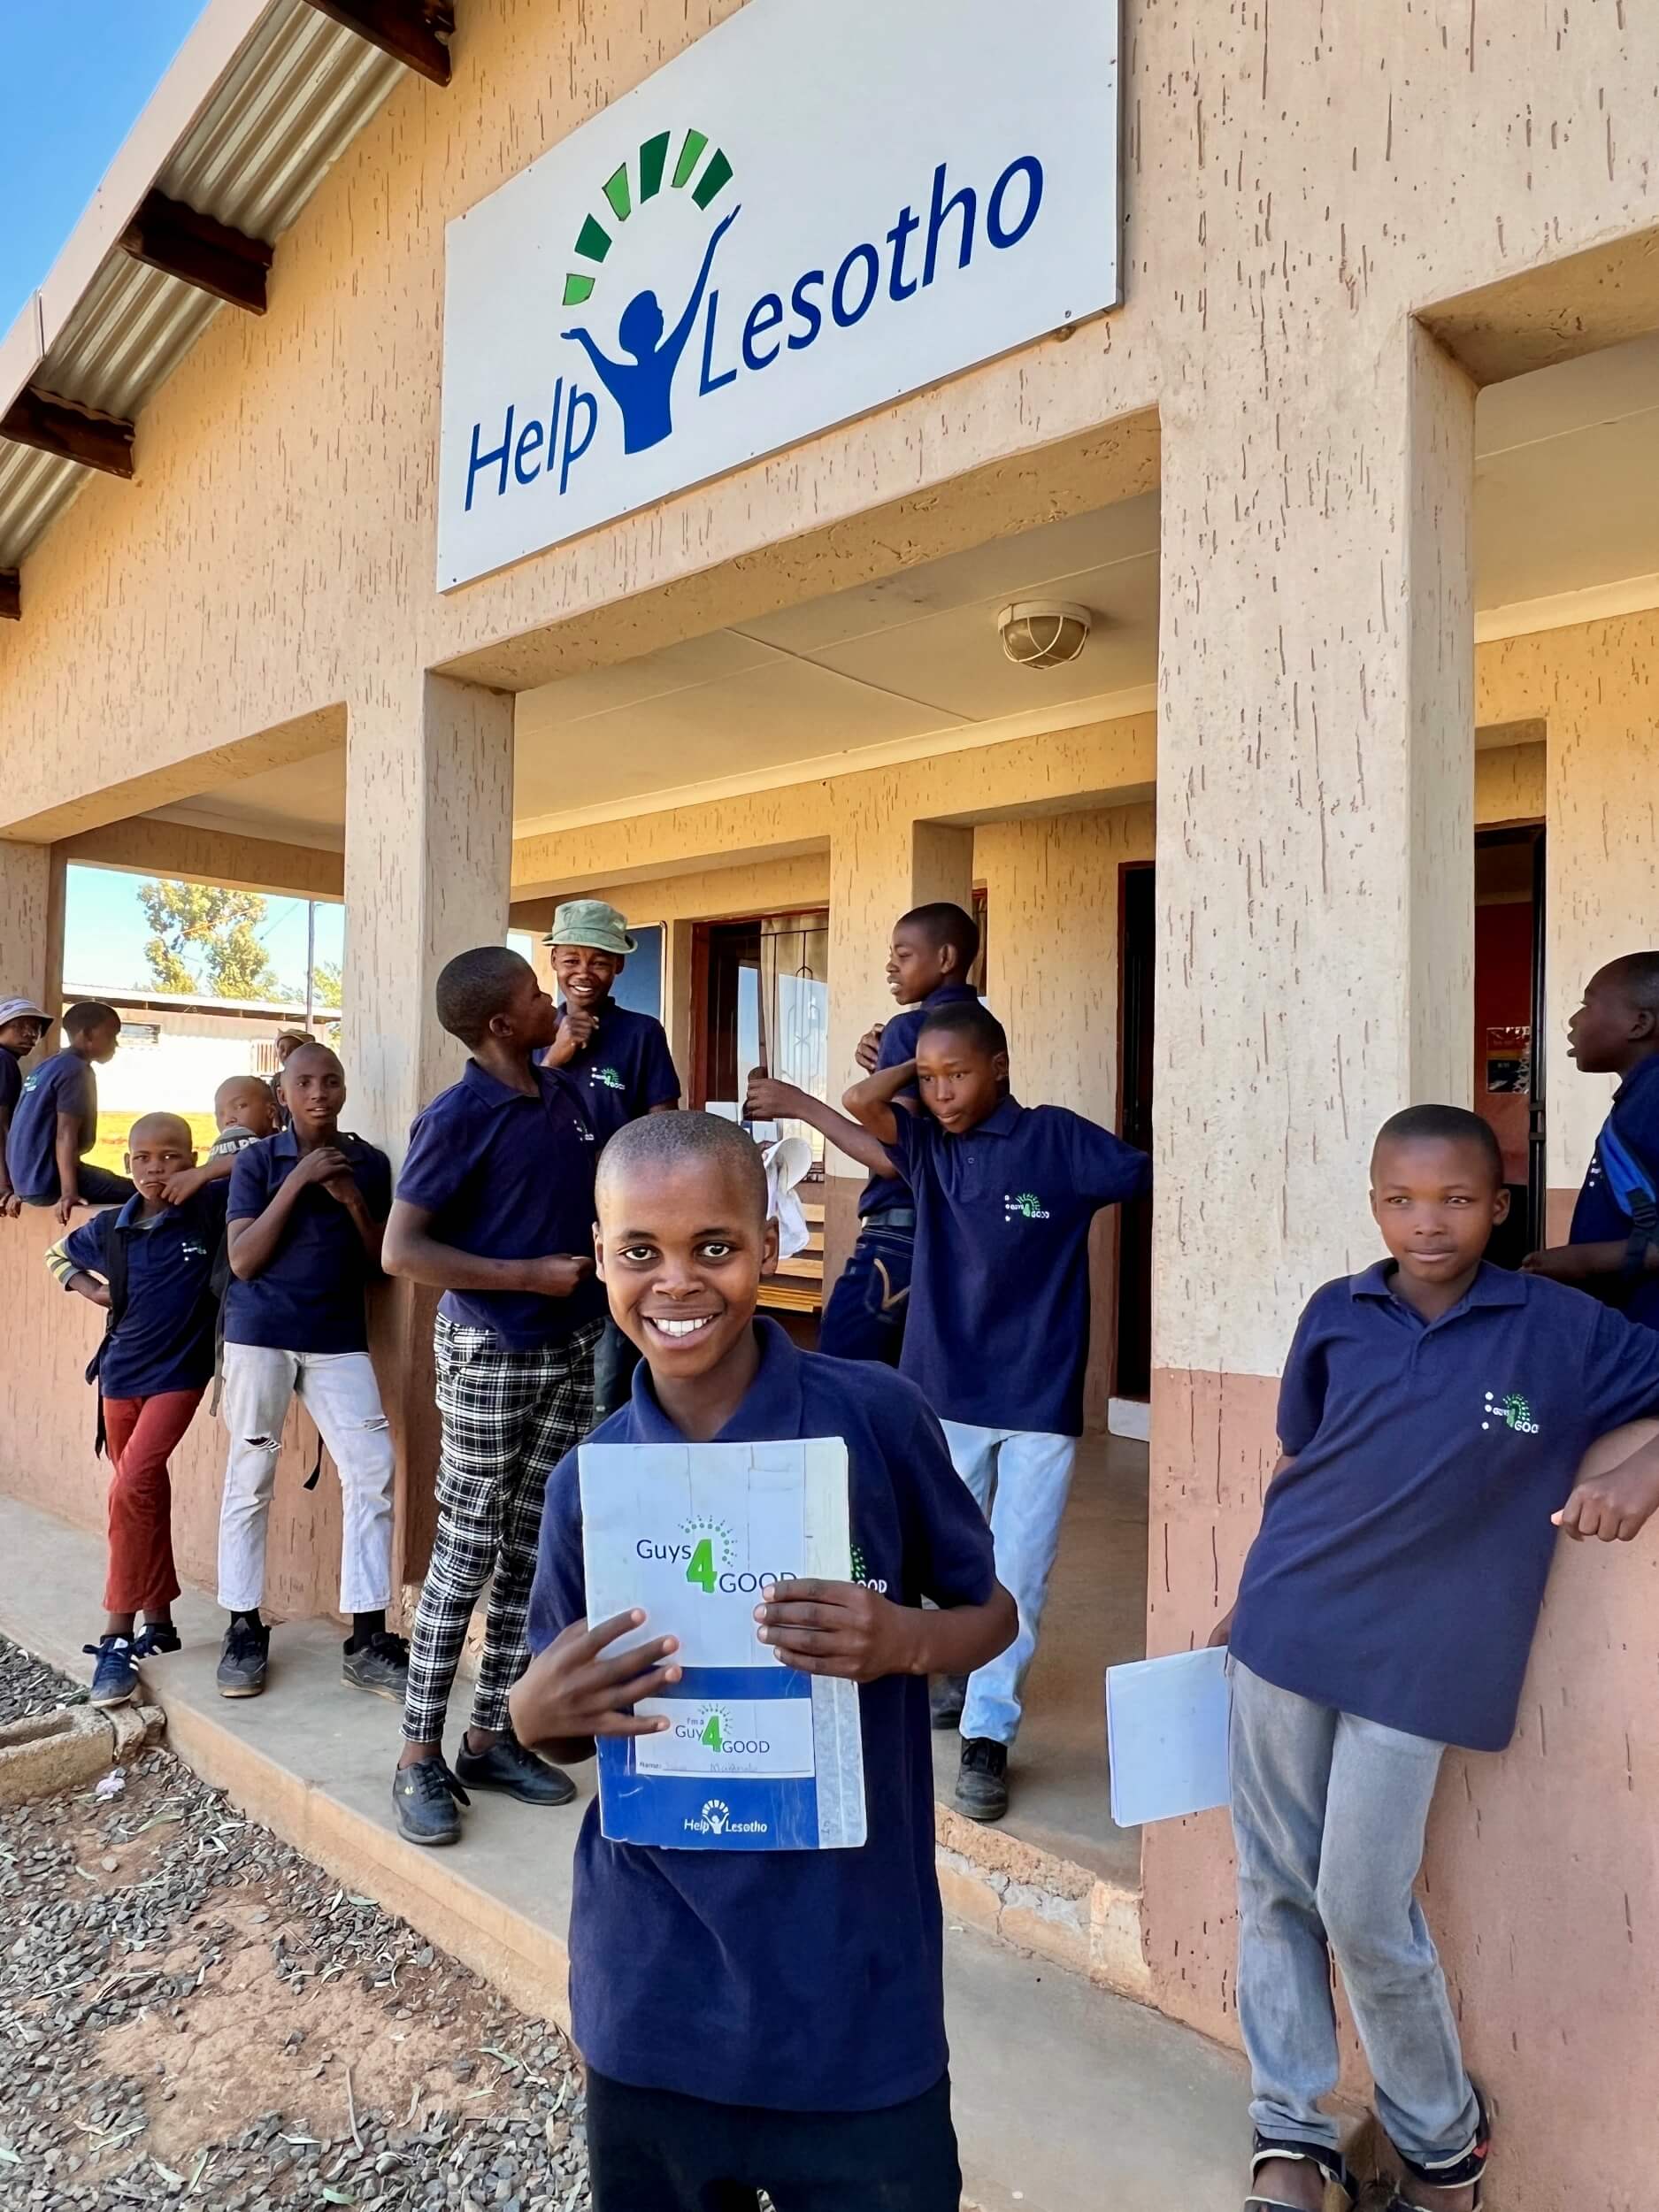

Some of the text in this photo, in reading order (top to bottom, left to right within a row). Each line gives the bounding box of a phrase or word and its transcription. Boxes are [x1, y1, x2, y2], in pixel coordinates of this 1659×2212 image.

[465, 156, 1044, 511] Help Lesotho
[636, 1539, 692, 1563] Guys
[686, 1538, 718, 1594] 4
[675, 1715, 770, 1754] Guy 4 GOOD
[684, 1818, 768, 1835] Help Lesotho
